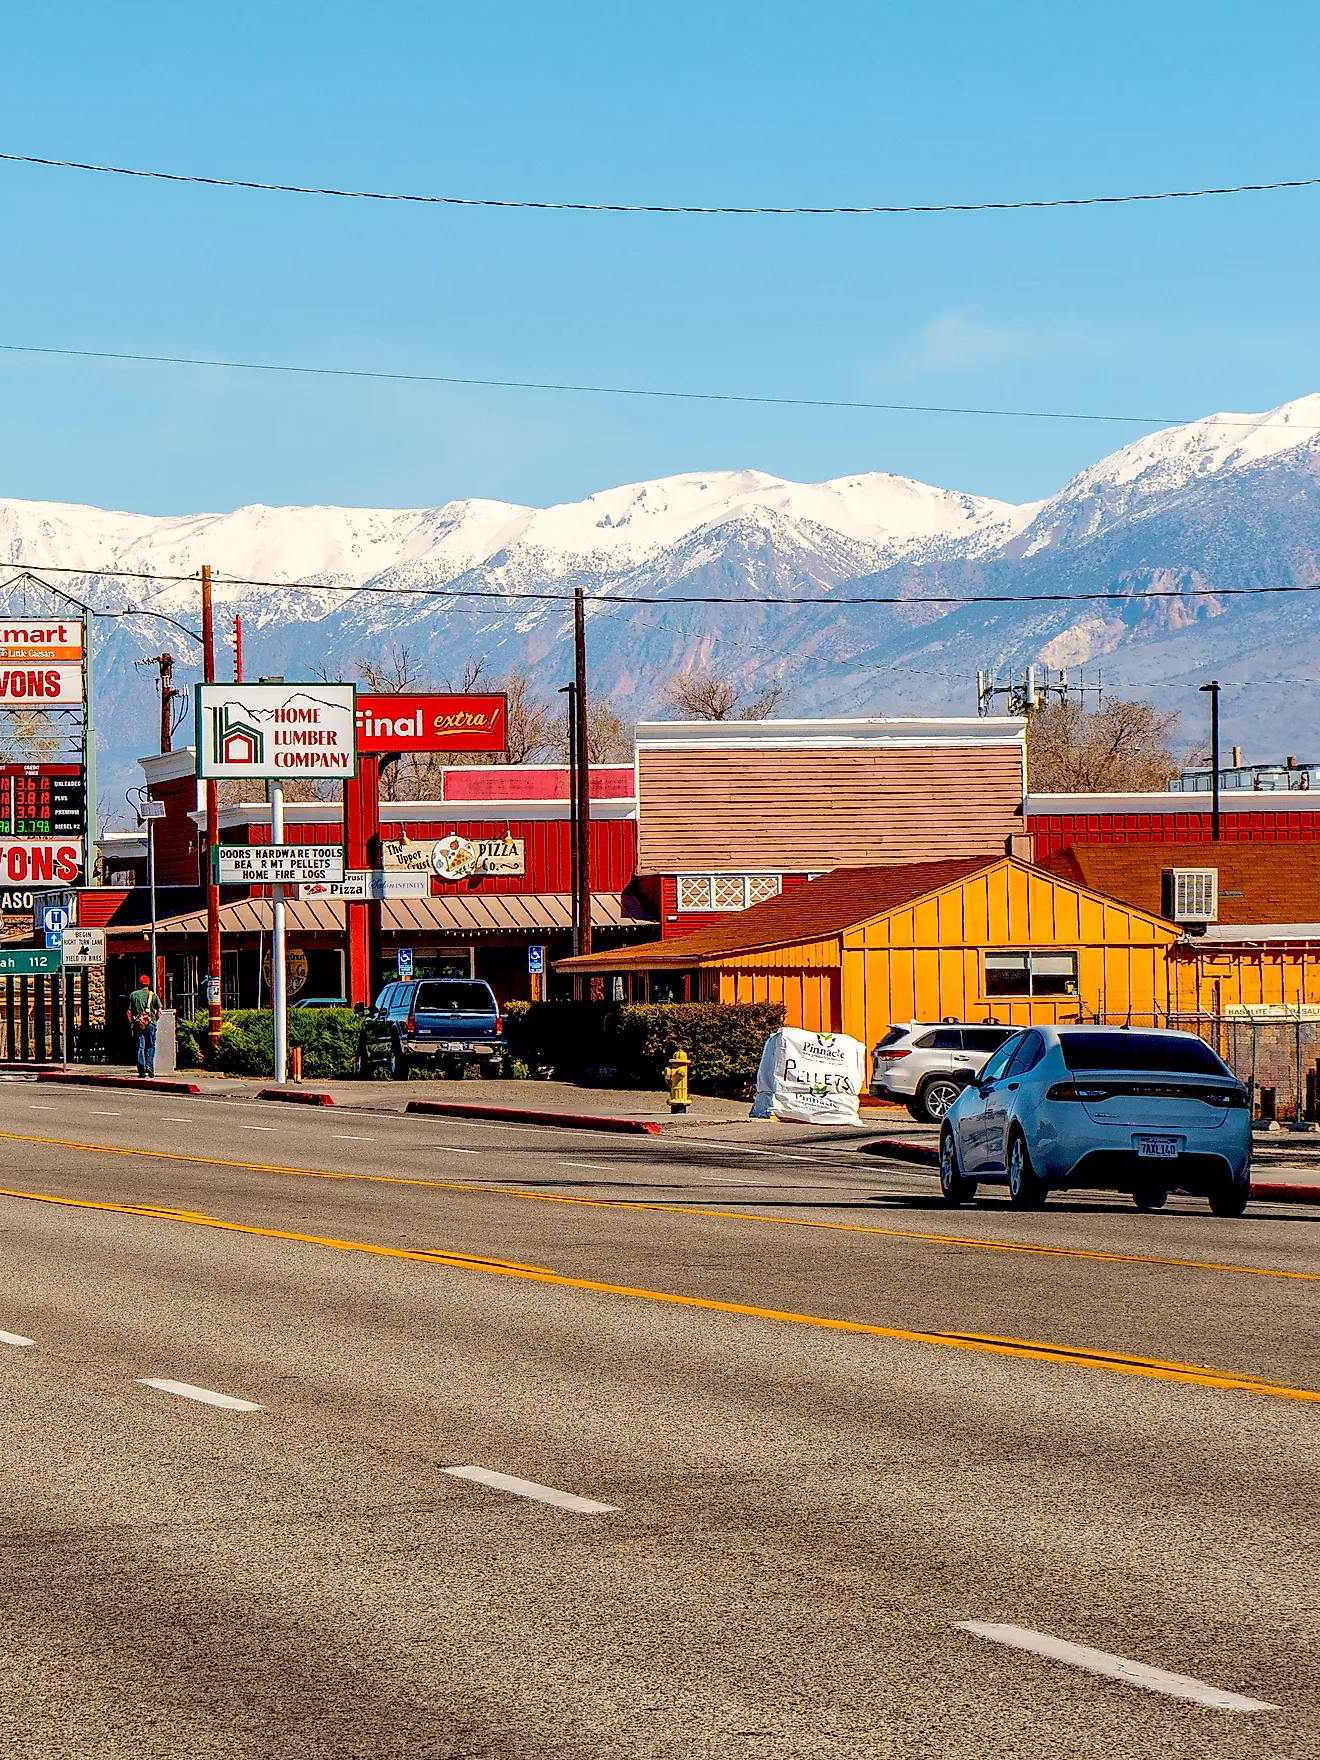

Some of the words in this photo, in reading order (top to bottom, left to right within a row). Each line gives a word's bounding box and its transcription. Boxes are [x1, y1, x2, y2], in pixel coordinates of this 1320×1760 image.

[9, 649, 27, 658] Little
[28, 649, 55, 658] Caesars
[274, 708, 320, 724] HOME
[274, 731, 337, 746] LUMBER
[274, 752, 349, 768] COMPANY
[220, 849, 251, 859] DOORS
[312, 848, 343, 858] TOOLS
[386, 844, 403, 855] The
[479, 843, 519, 857] PIZZA
[290, 859, 331, 868] PELLETS
[396, 850, 422, 865] Upper
[242, 870, 269, 879] HOME
[275, 870, 296, 879] FIRE
[302, 870, 326, 879] LOGS
[329, 884, 363, 895] Pizza
[29, 957, 48, 967] 112
[803, 1041, 845, 1059] Pinnacle
[783, 1059, 850, 1091] PELLETS
[1140, 1143, 1176, 1155] 7AXL140
